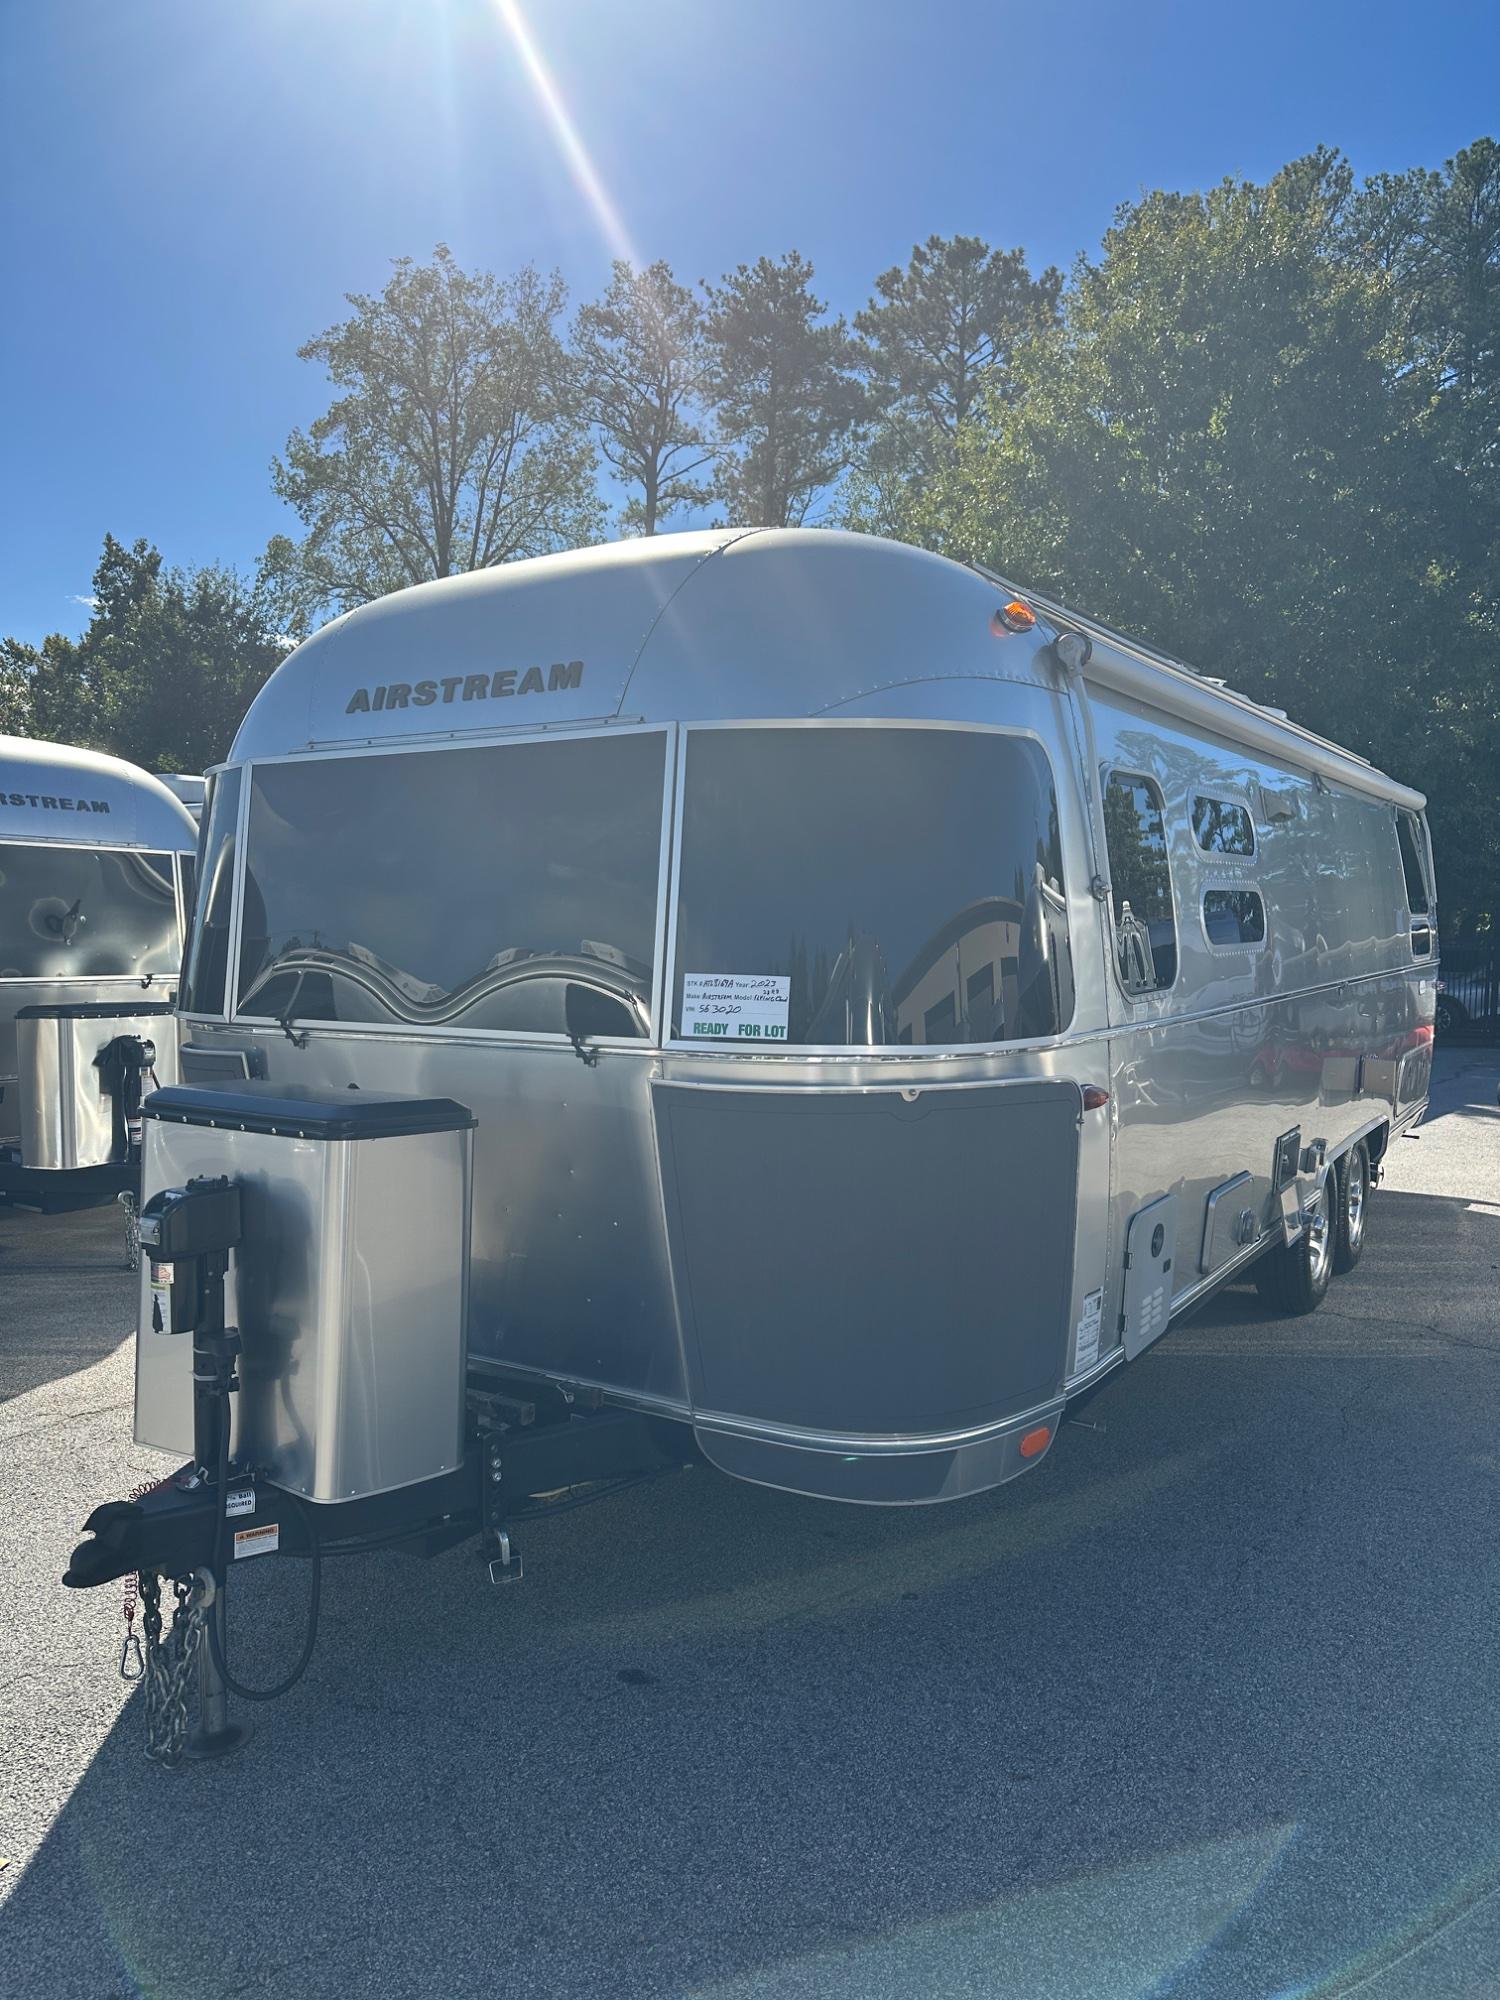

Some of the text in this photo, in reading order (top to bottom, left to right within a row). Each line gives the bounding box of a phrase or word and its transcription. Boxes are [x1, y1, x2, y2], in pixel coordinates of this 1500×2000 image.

[345, 660, 584, 714] AIRSTREAM
[751, 979, 777, 988] 2023
[693, 1022, 786, 1038] READY FOR LOT
